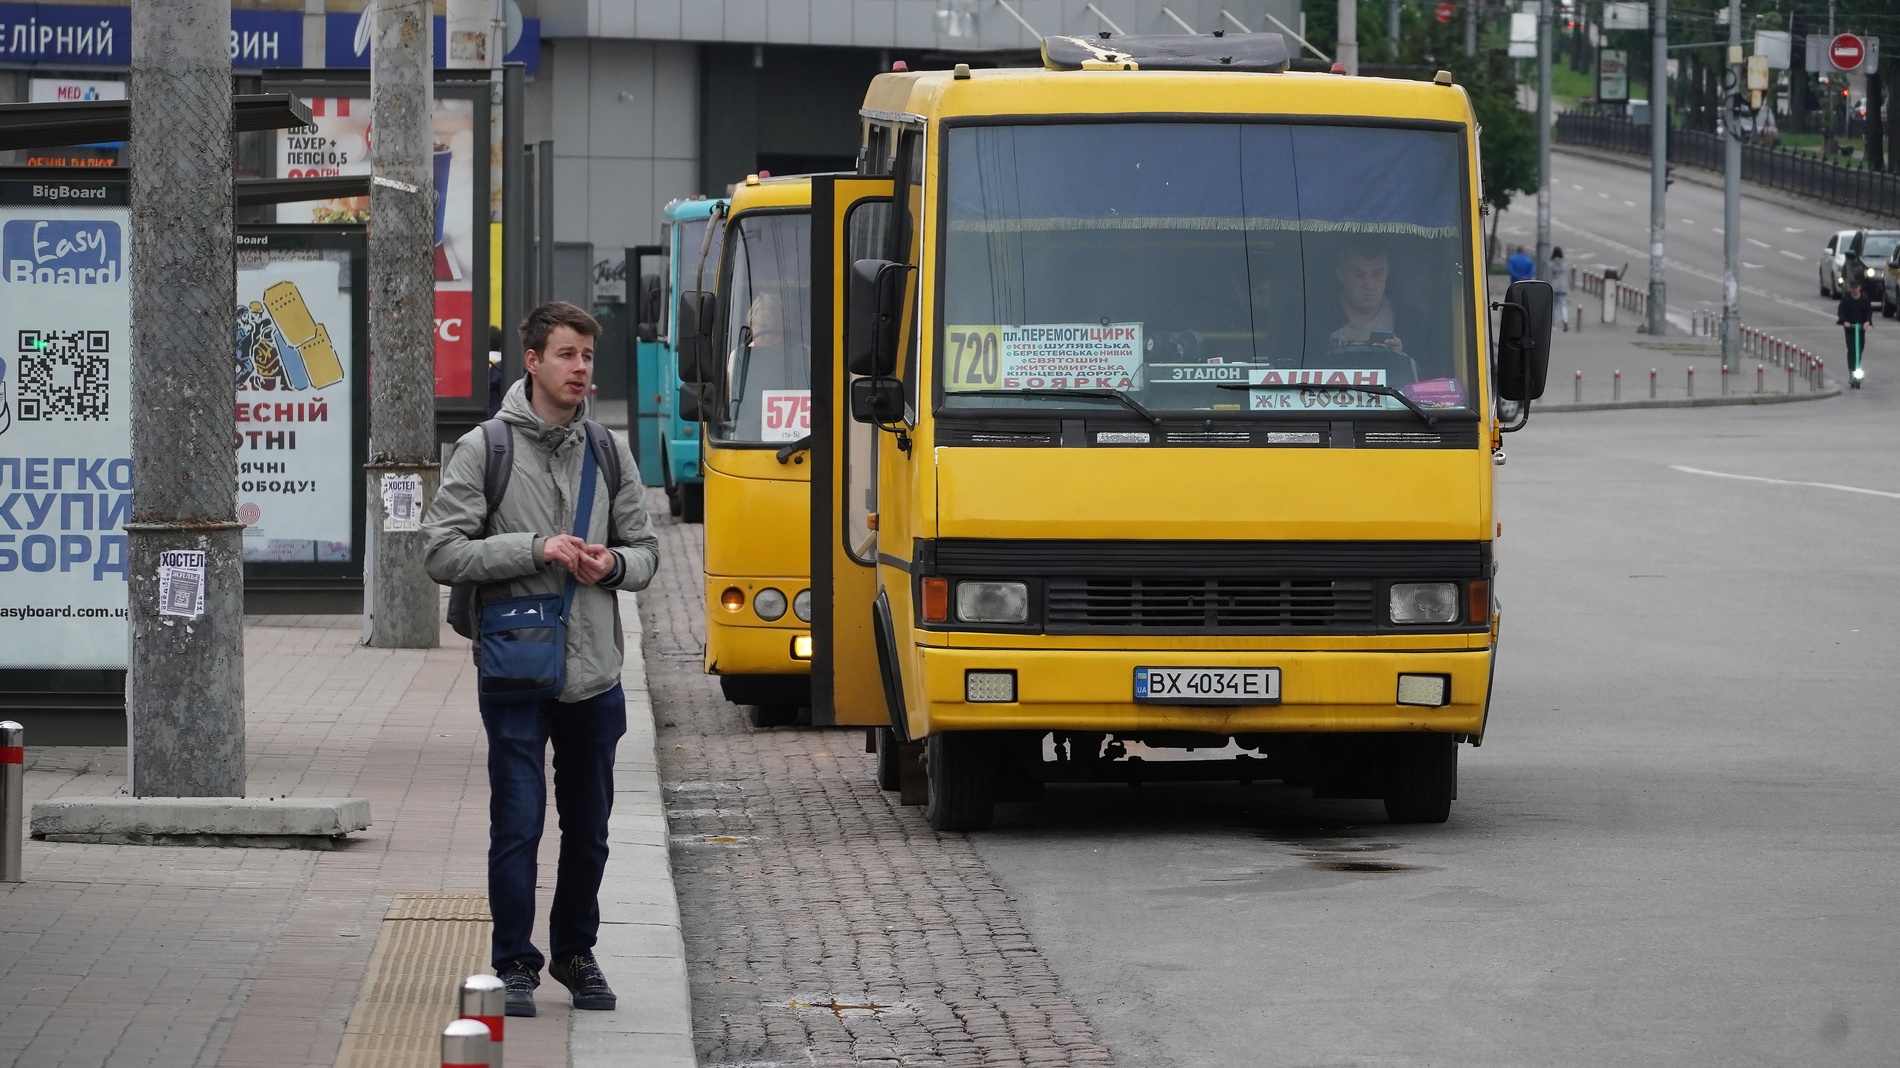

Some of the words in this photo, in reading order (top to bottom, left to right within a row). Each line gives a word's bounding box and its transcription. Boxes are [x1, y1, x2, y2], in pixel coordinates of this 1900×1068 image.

[58, 86, 81, 99] MED
[287, 137, 327, 149] ТАУЕР
[287, 152, 324, 165] ПЕПСІ
[328, 152, 347, 167] 0,5
[33, 185, 107, 200] BigBoard
[33, 221, 107, 264] Easy
[9, 259, 116, 284] Board
[1090, 328, 1136, 343] ЦИРК
[950, 332, 998, 385] 720
[1172, 368, 1241, 380] ЭТАЛОН
[1260, 371, 1379, 386] АШАН
[1003, 377, 1135, 388] БОЯРКА
[1299, 388, 1382, 408] СОФІЯ
[766, 396, 811, 429] 575
[0, 457, 134, 491] ЛЕГКО
[388, 480, 416, 491] ХОСТЕЛ
[0, 492, 132, 531] КУПИ
[0, 534, 128, 581] БОРД
[161, 552, 205, 568] ХОСТЕЛ
[1149, 672, 1182, 694] BX
[1187, 673, 1239, 694] 4034
[1243, 673, 1270, 694] EI
